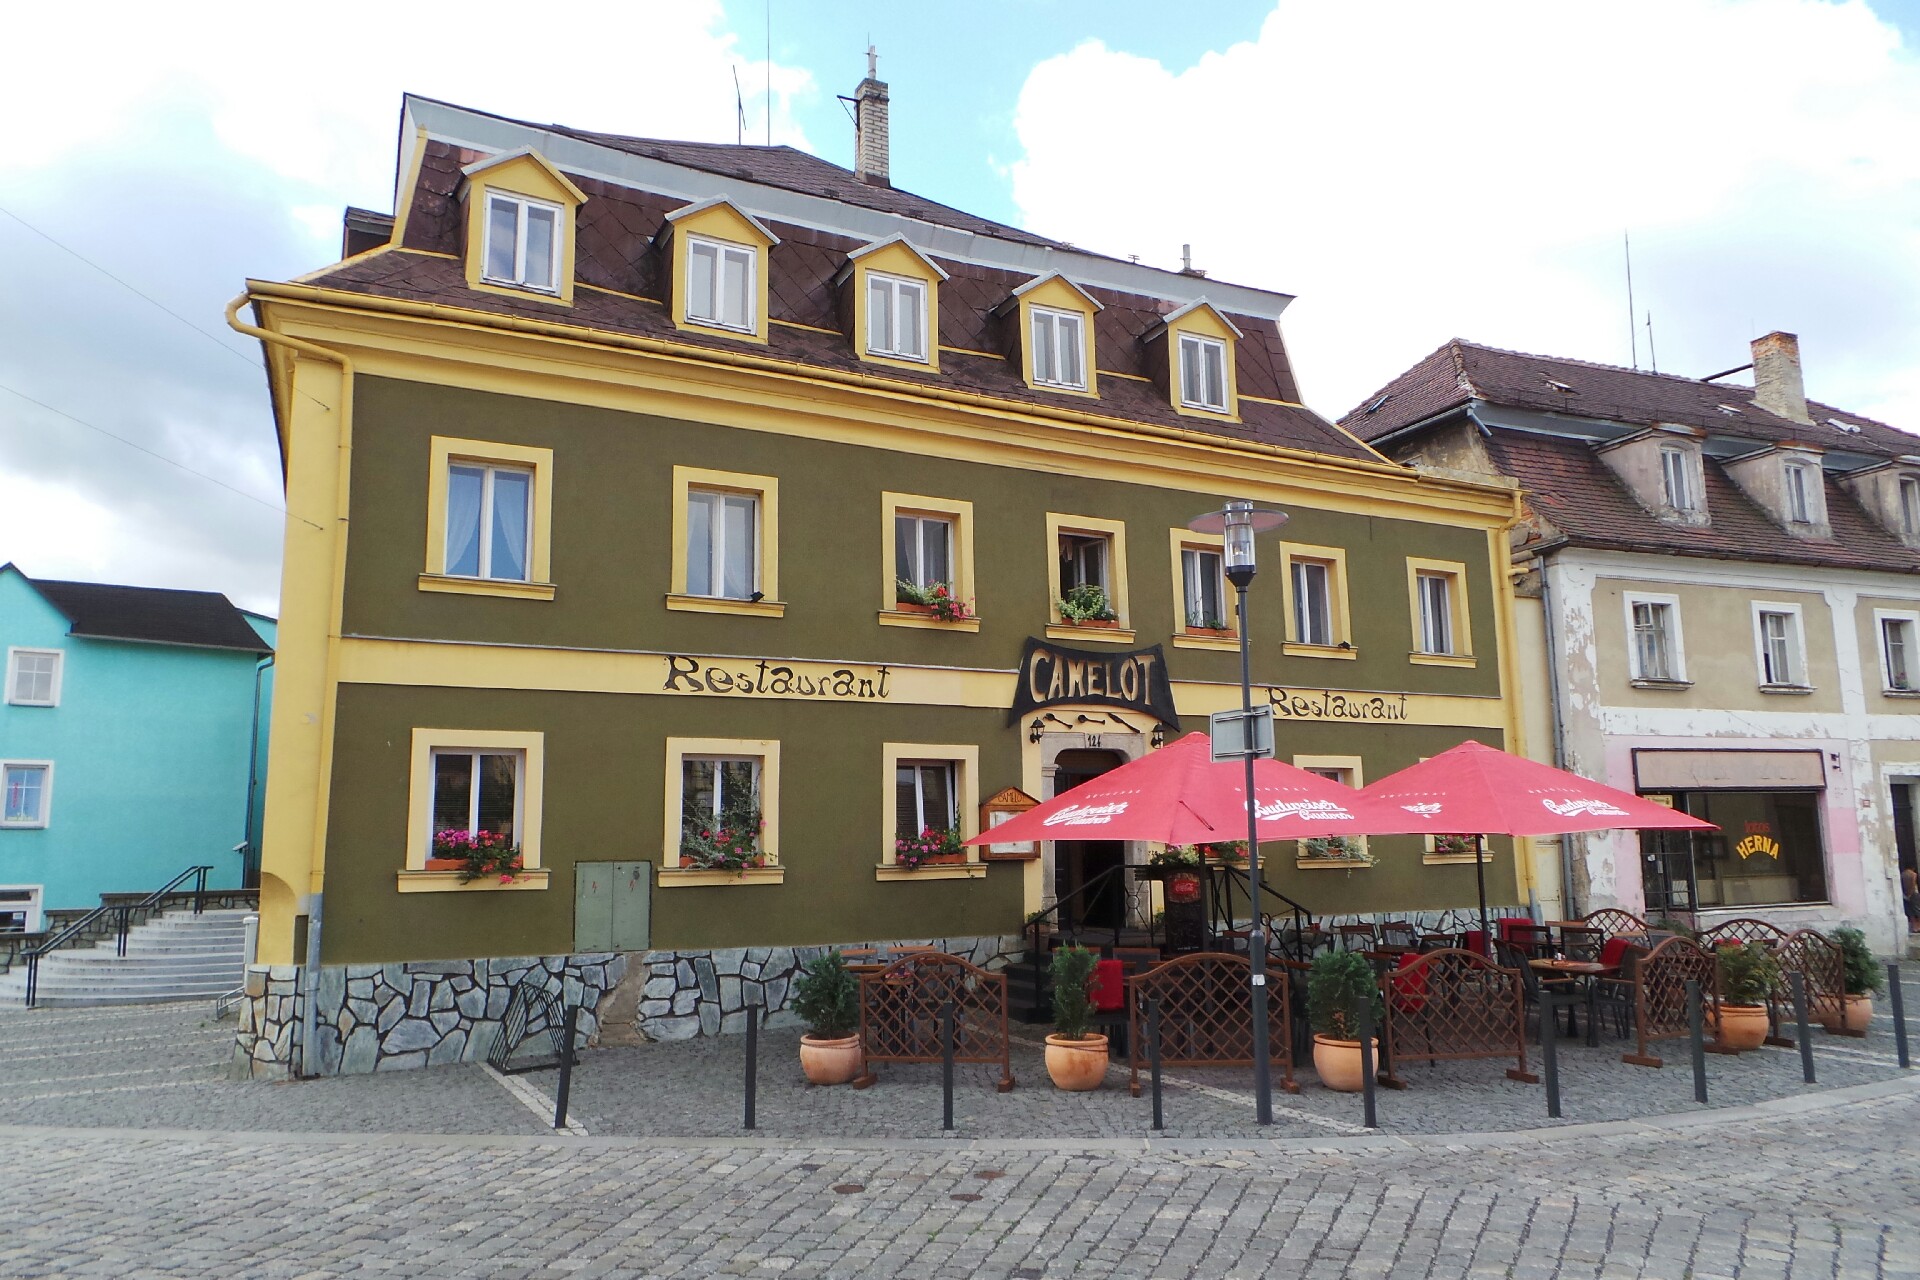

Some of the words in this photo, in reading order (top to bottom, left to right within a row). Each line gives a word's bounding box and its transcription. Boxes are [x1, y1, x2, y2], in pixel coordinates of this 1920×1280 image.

[663, 656, 891, 699] Restaurant
[1030, 648, 1156, 706] CAMELOT
[1265, 687, 1408, 720] Restaurant
[1736, 834, 1779, 860] HERNA
